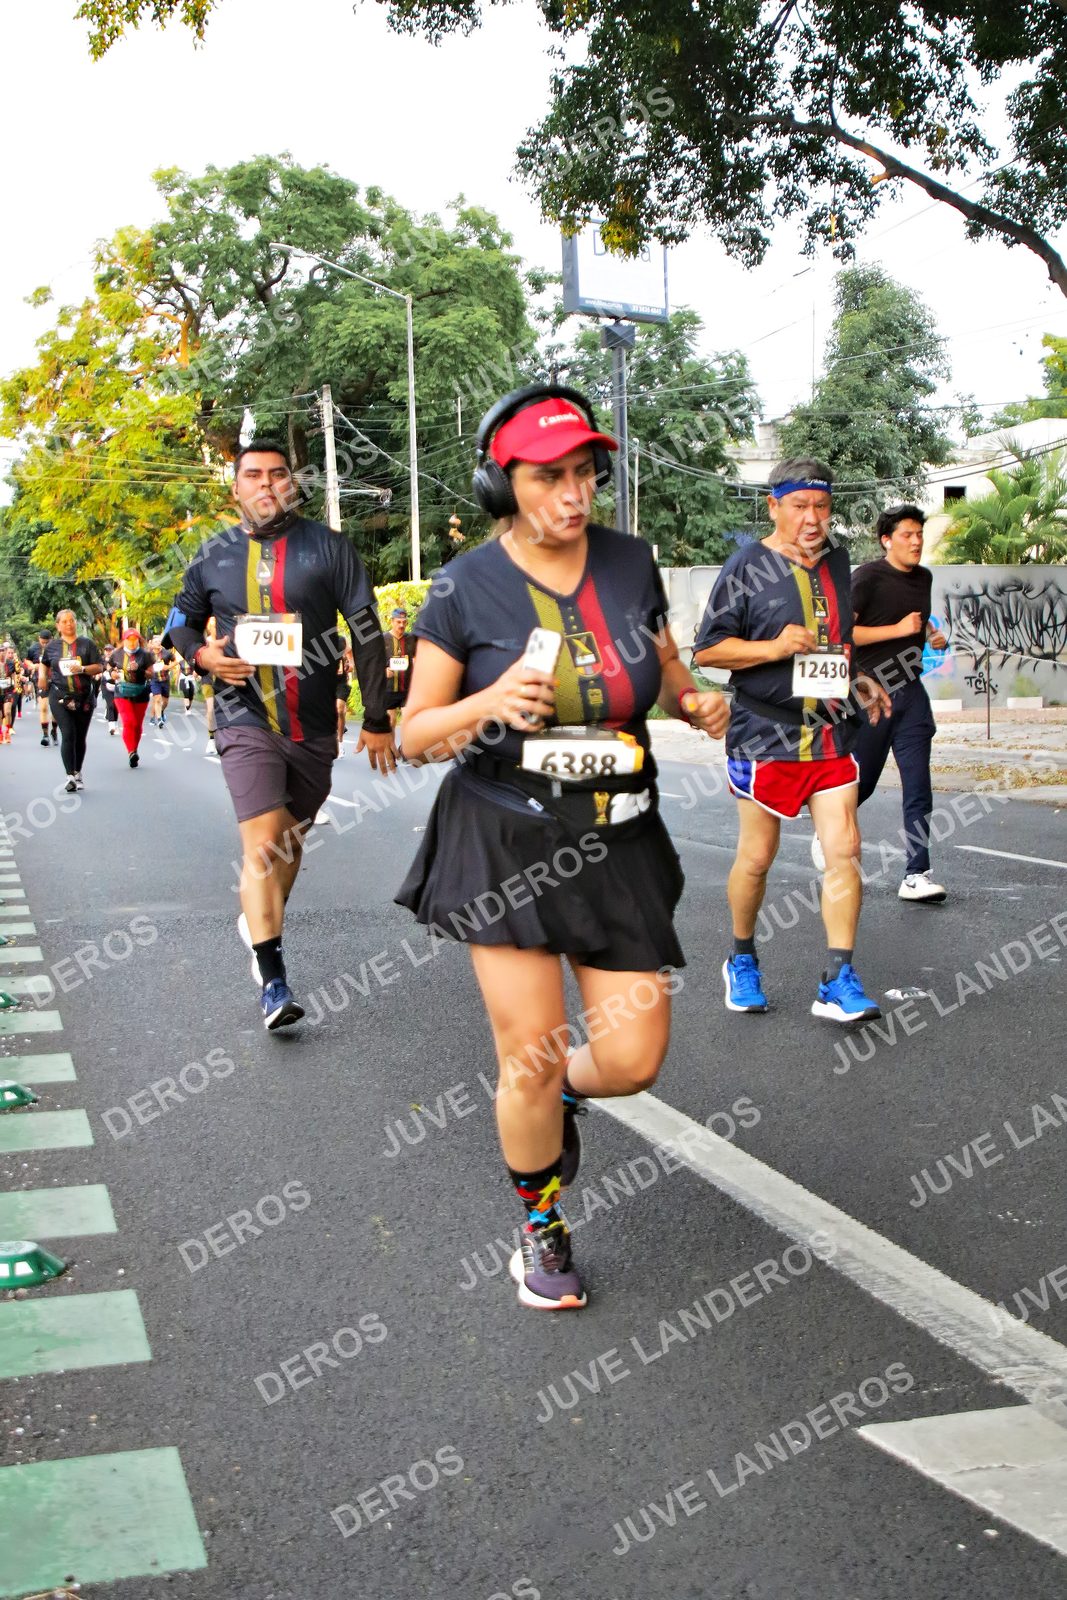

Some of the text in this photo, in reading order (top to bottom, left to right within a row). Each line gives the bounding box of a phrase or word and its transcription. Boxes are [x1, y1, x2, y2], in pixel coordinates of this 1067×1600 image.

[252, 629, 284, 646] 790
[798, 660, 848, 679] 12430
[541, 751, 617, 776] 6388
